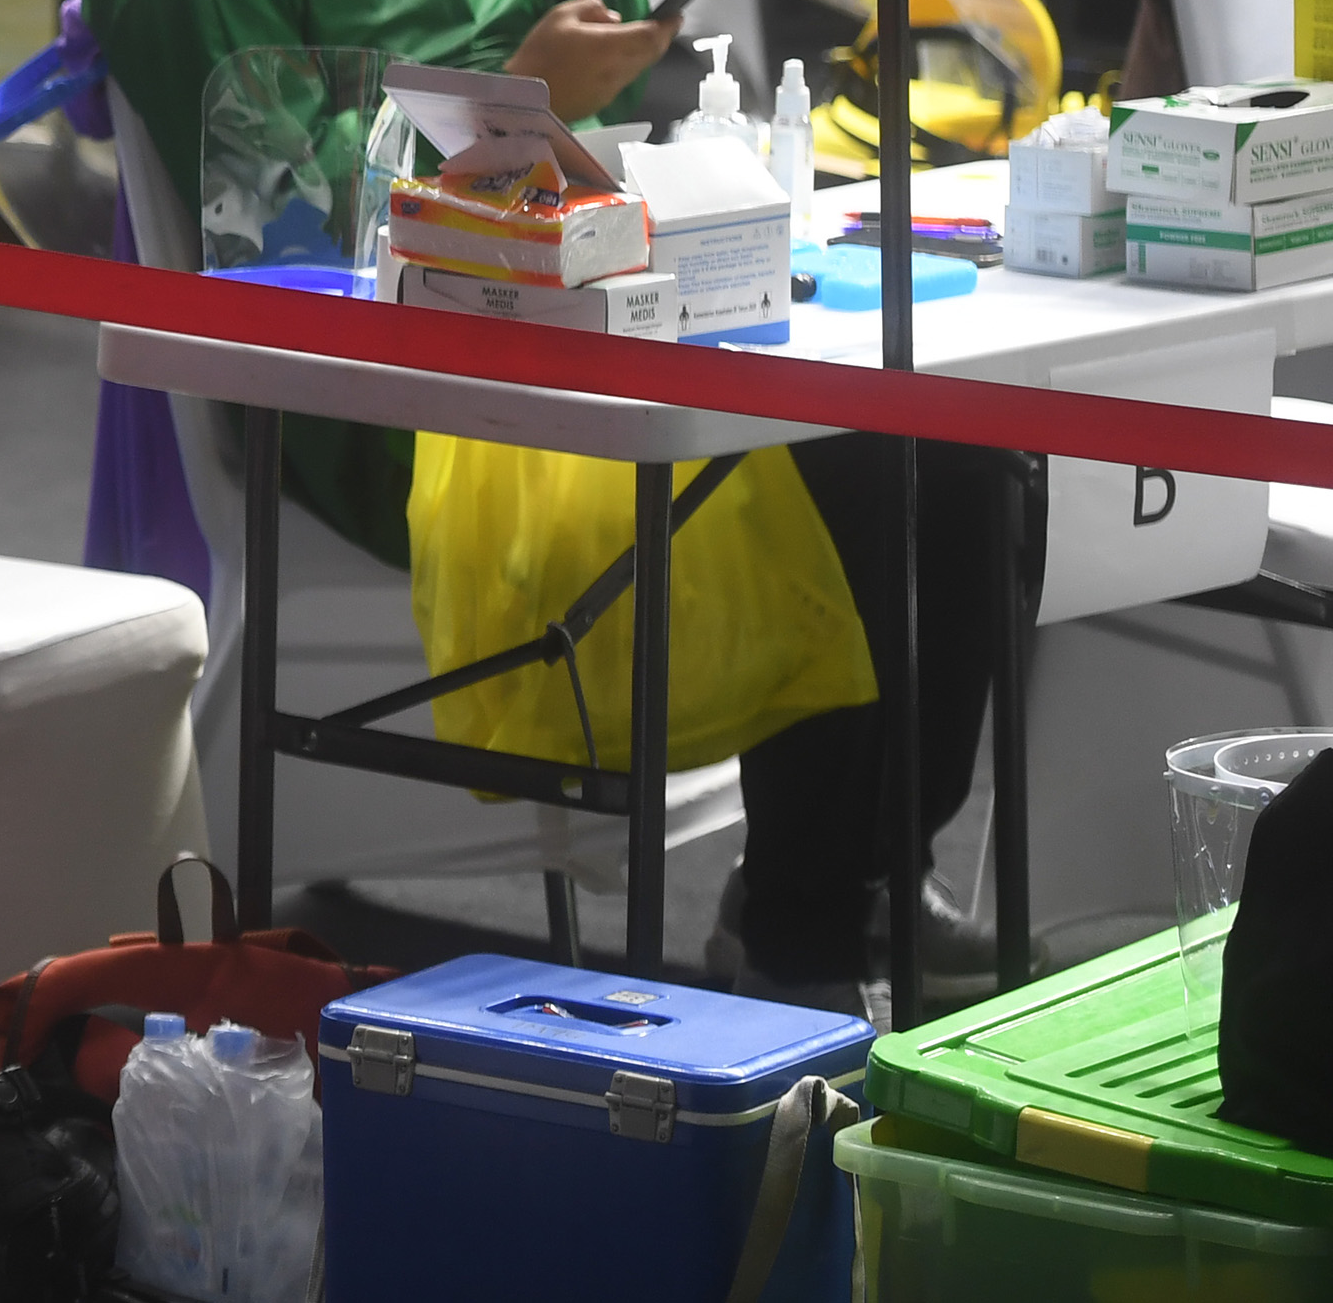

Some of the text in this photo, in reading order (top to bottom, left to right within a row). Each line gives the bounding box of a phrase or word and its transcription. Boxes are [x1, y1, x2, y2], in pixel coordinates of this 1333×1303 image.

[482, 287, 520, 299] MASKER
[626, 292, 660, 307] MASKER
[486, 297, 514, 310] MEDIS
[630, 307, 656, 323] MEDIS
